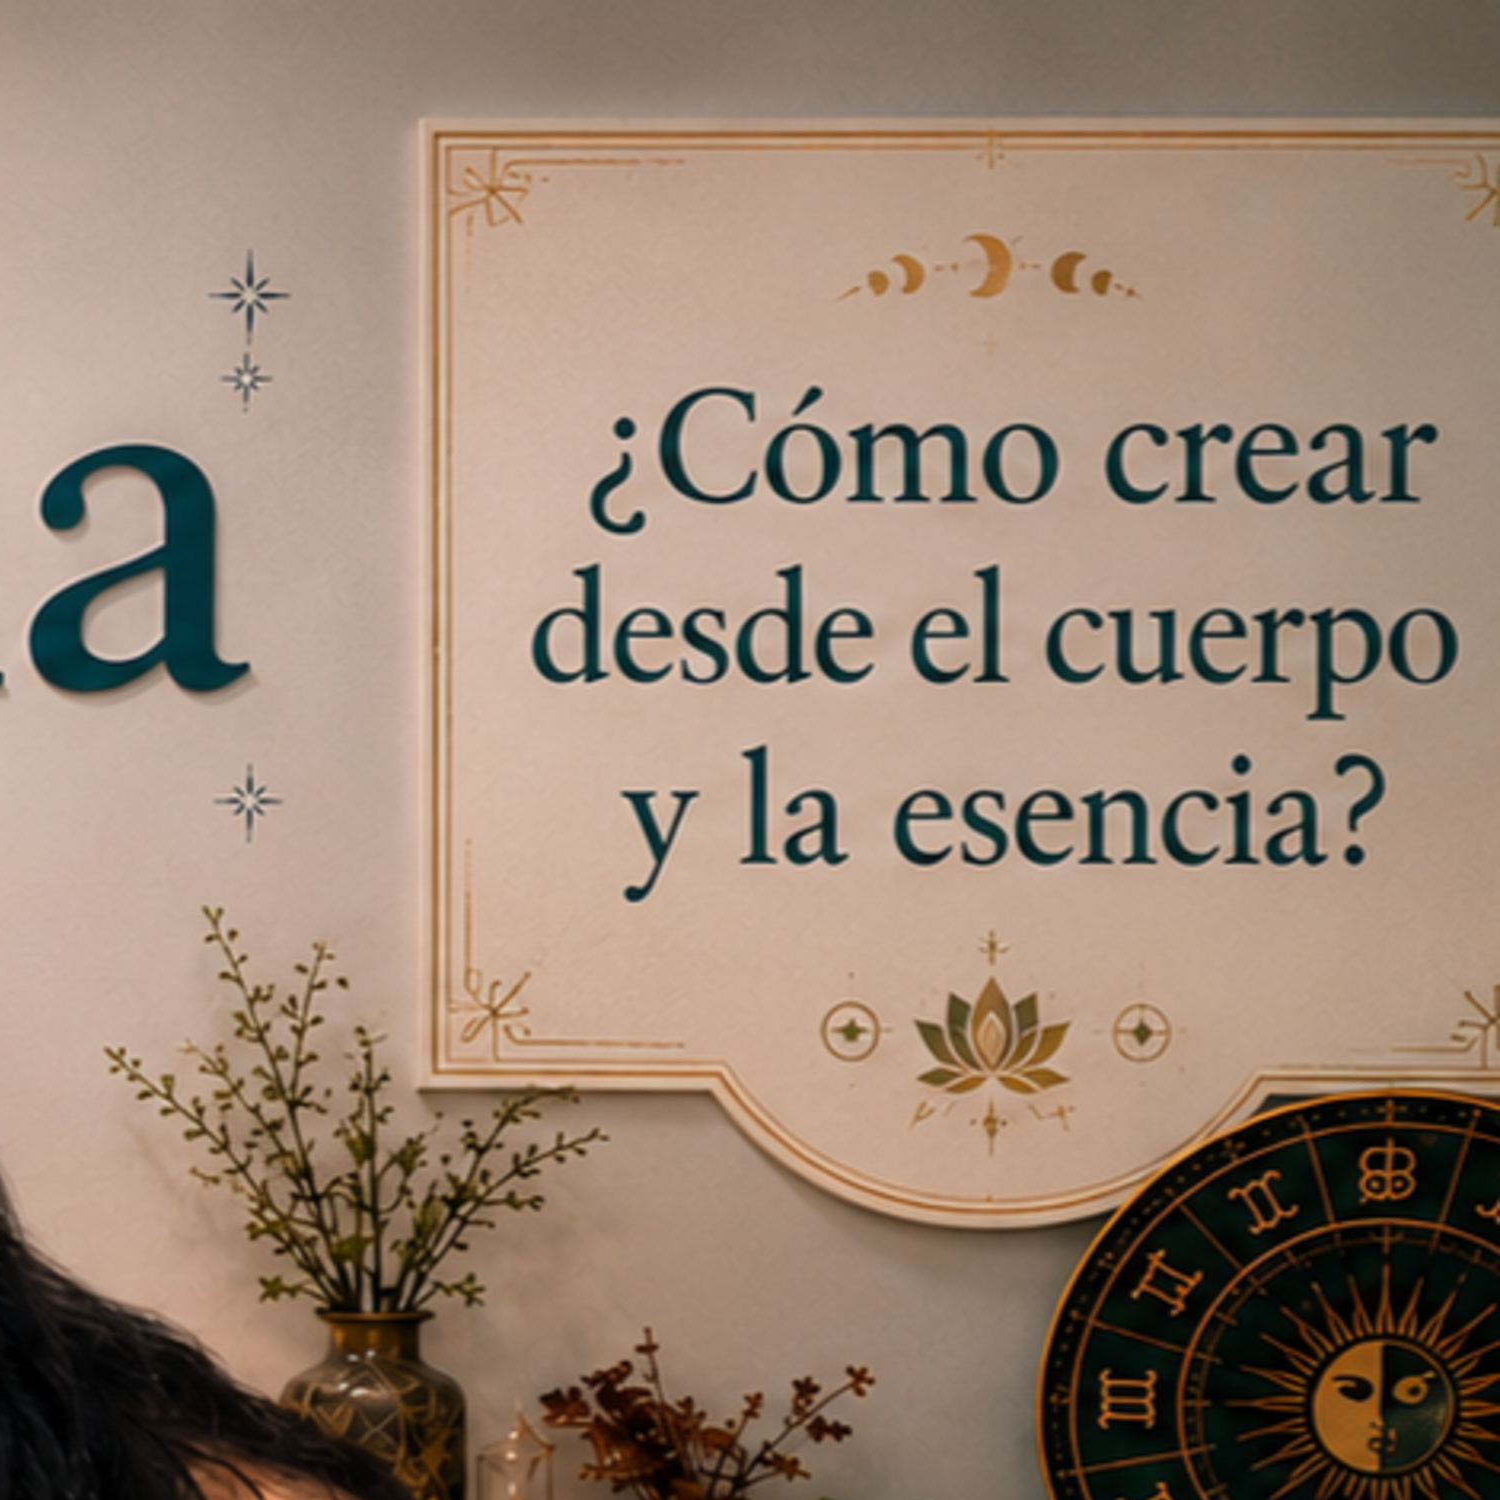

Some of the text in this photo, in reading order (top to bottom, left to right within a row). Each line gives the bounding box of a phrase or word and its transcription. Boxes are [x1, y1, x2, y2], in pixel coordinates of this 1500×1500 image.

[589, 385, 1438, 536] ¿Cómo crear
[531, 564, 1459, 722] desde el cuerpo
[620, 744, 1386, 903] y la esencia?
